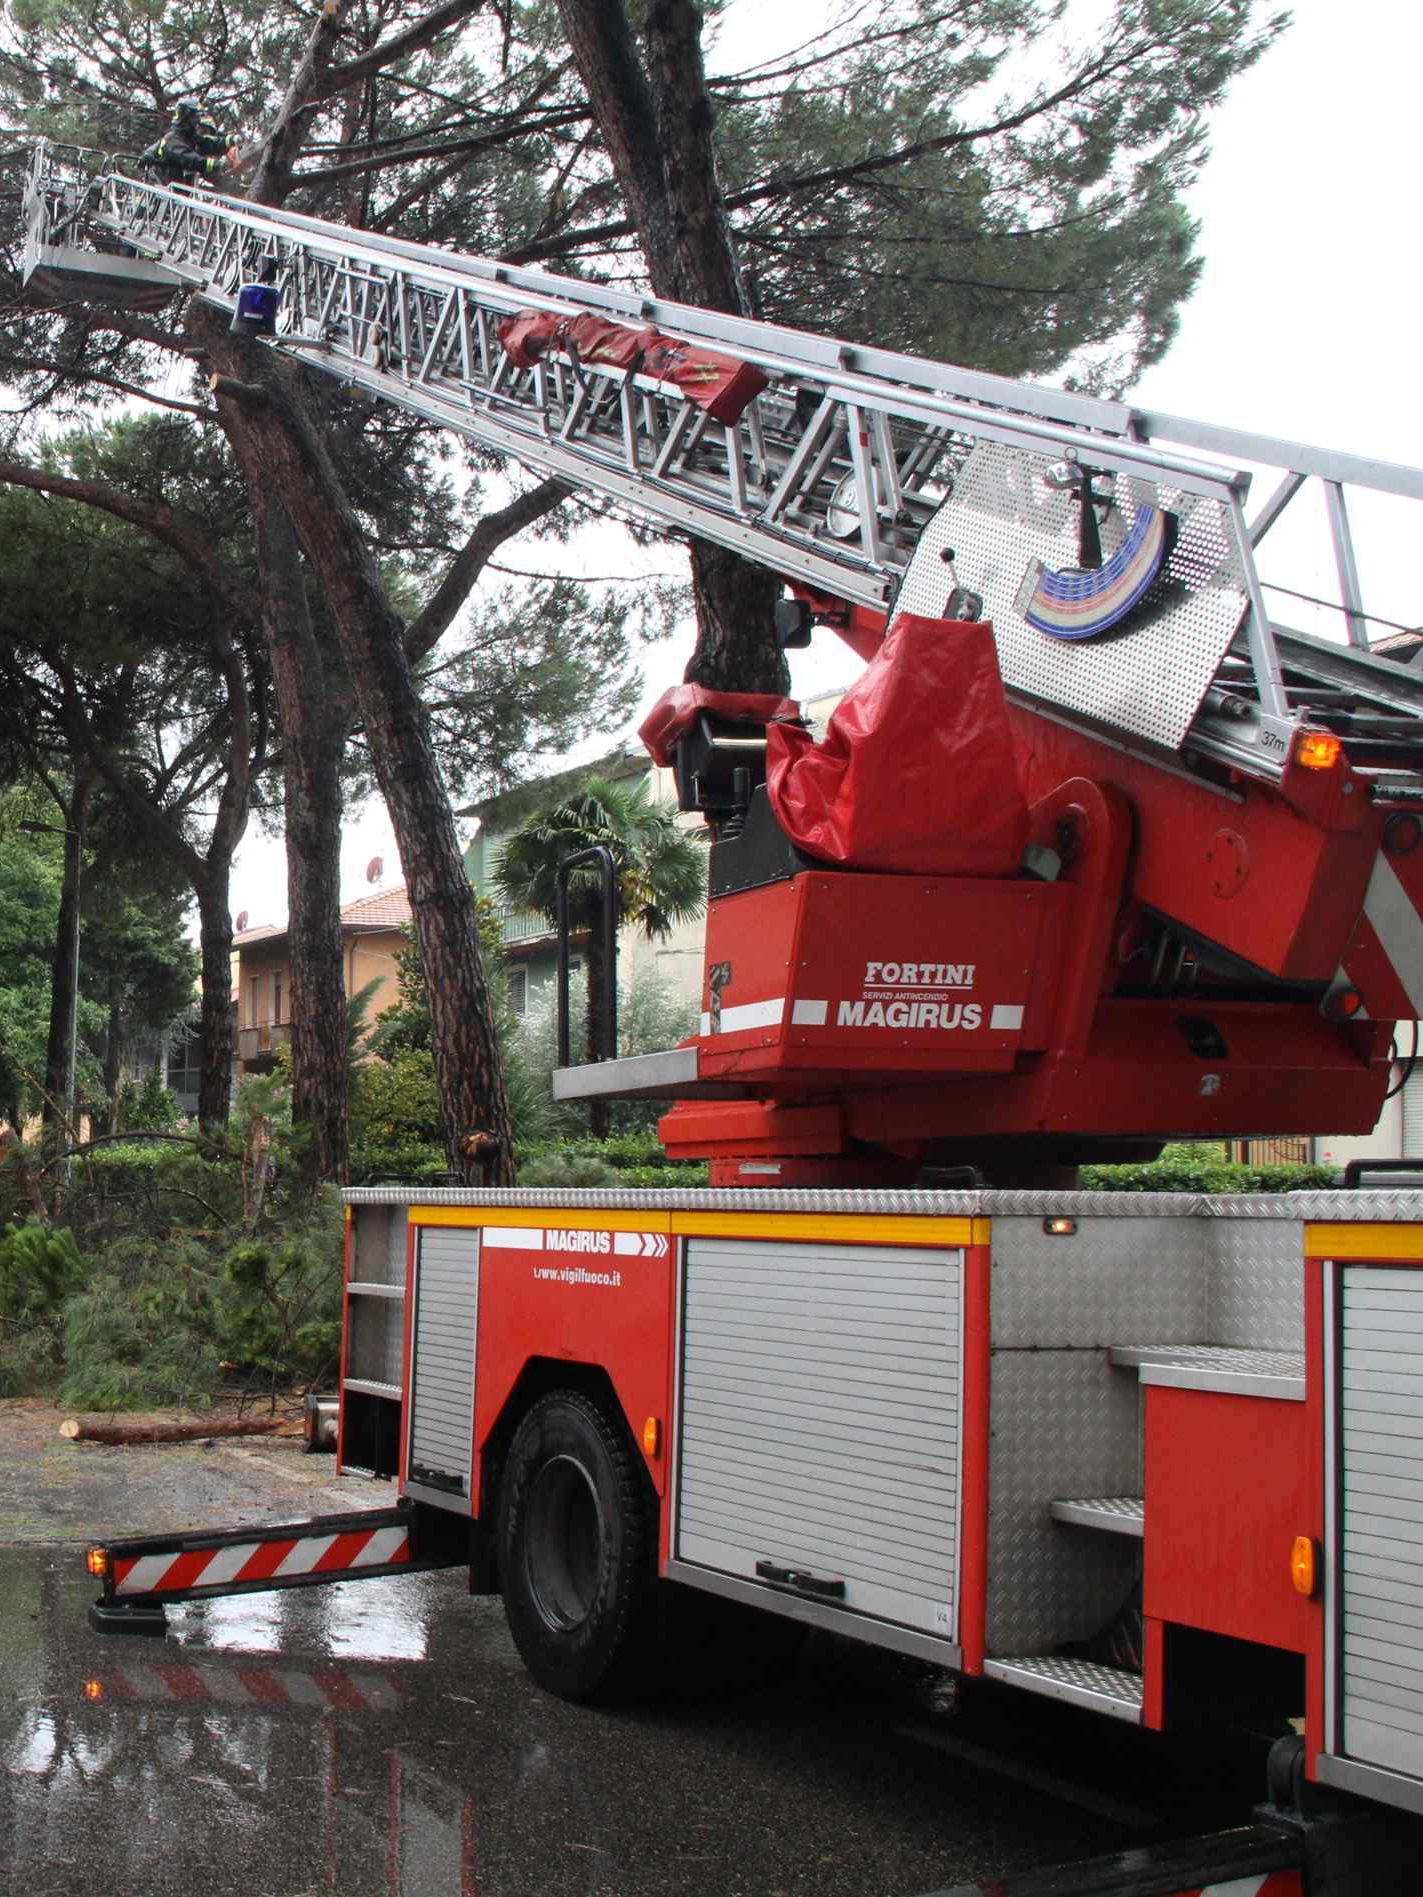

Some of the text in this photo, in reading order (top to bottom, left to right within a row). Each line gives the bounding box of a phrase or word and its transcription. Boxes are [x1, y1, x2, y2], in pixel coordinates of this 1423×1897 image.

[1261, 730, 1285, 753] 37m
[864, 962, 976, 985] FORTINI
[862, 991, 949, 1001] SERVIZI ANTINCENDIO
[837, 1000, 983, 1031] MAGIRUS
[546, 1229, 612, 1254] MAGIRUS
